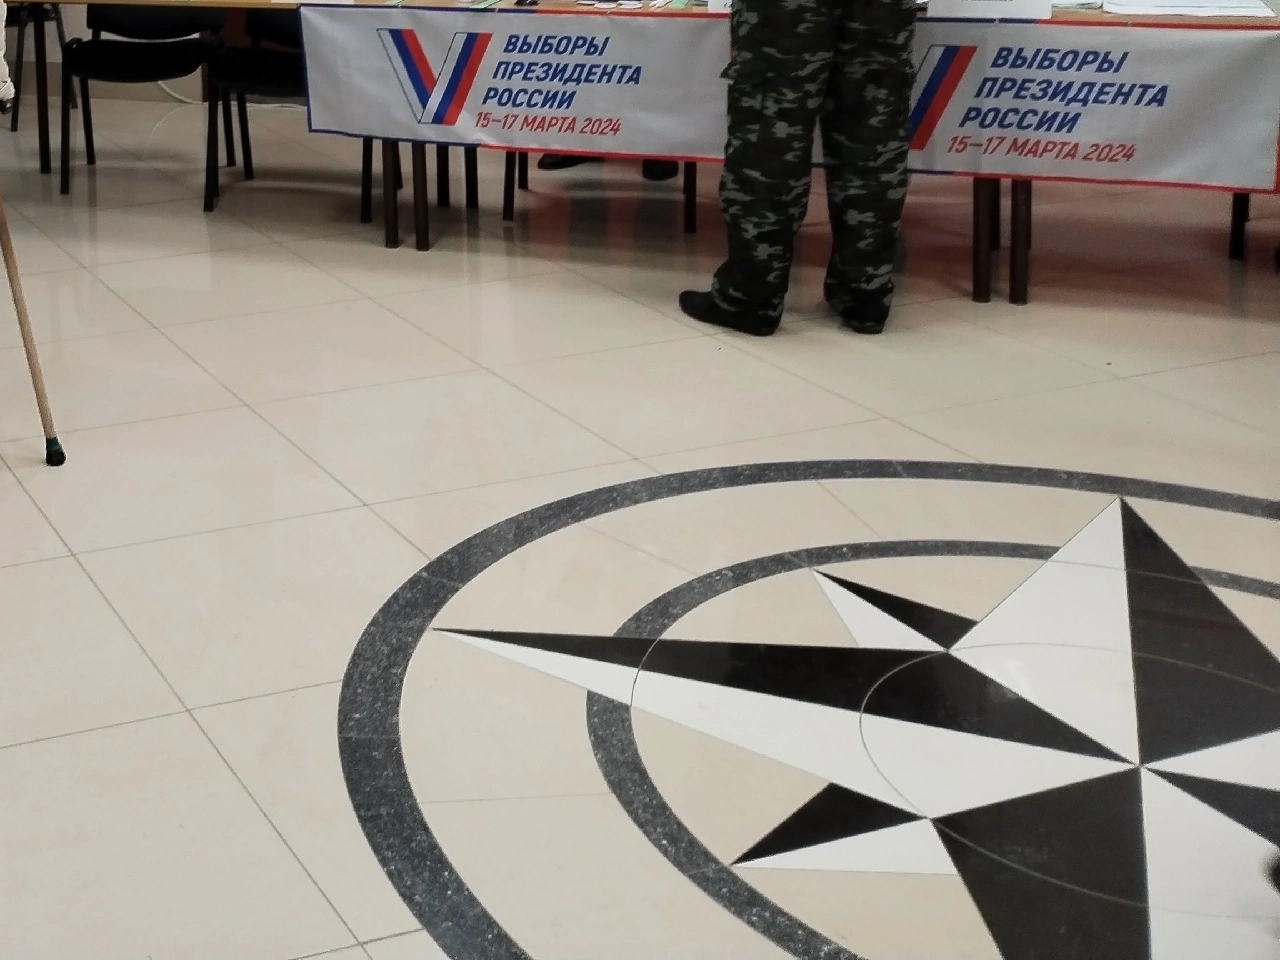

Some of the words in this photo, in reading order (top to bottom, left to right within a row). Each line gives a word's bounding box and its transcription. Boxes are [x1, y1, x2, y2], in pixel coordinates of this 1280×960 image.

[503, 34, 612, 57] ВЫБОРЫ
[990, 46, 1130, 74] ВЫБОРЫ
[492, 61, 642, 86] ПРЕЗИДЕНТА
[482, 87, 577, 110] РОССИИ
[973, 77, 1169, 107] ПРЕЗИДЕНТА
[519, 114, 577, 134] МАРТА
[579, 117, 622, 136] 2024
[958, 106, 1082, 134] РОССИИ
[1005, 138, 1080, 161] МАРТА
[1081, 143, 1137, 163] 2024
